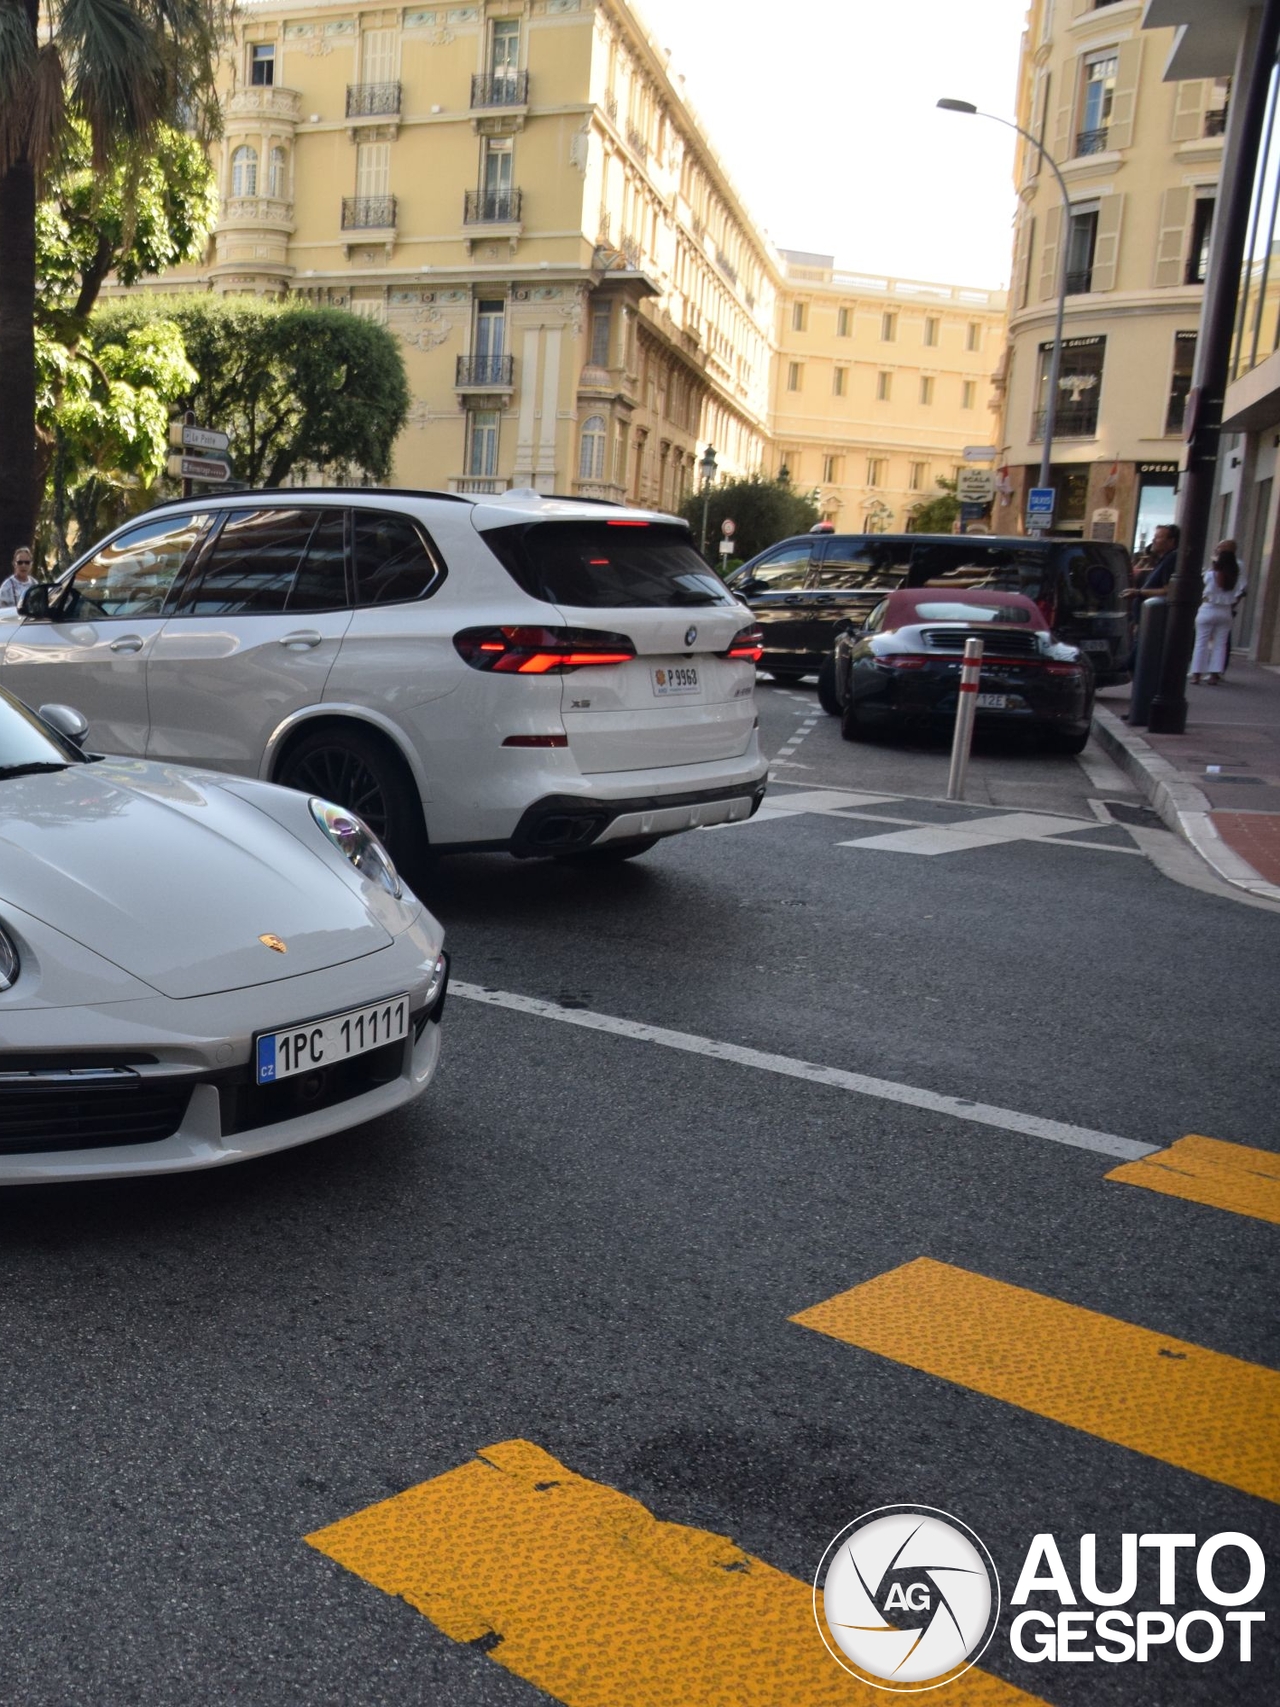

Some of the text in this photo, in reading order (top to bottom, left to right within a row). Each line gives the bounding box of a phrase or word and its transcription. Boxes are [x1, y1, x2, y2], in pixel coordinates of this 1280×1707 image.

[1044, 337, 1100, 350] OPA GALLERY
[1140, 464, 1176, 472] OPERA
[1031, 496, 1051, 505] TAXIS
[667, 668, 698, 687] P 9963
[570, 699, 591, 709] X5
[976, 694, 1004, 706] 12E
[278, 1002, 405, 1072] 1PC 11111
[260, 1065, 275, 1078] CZ
